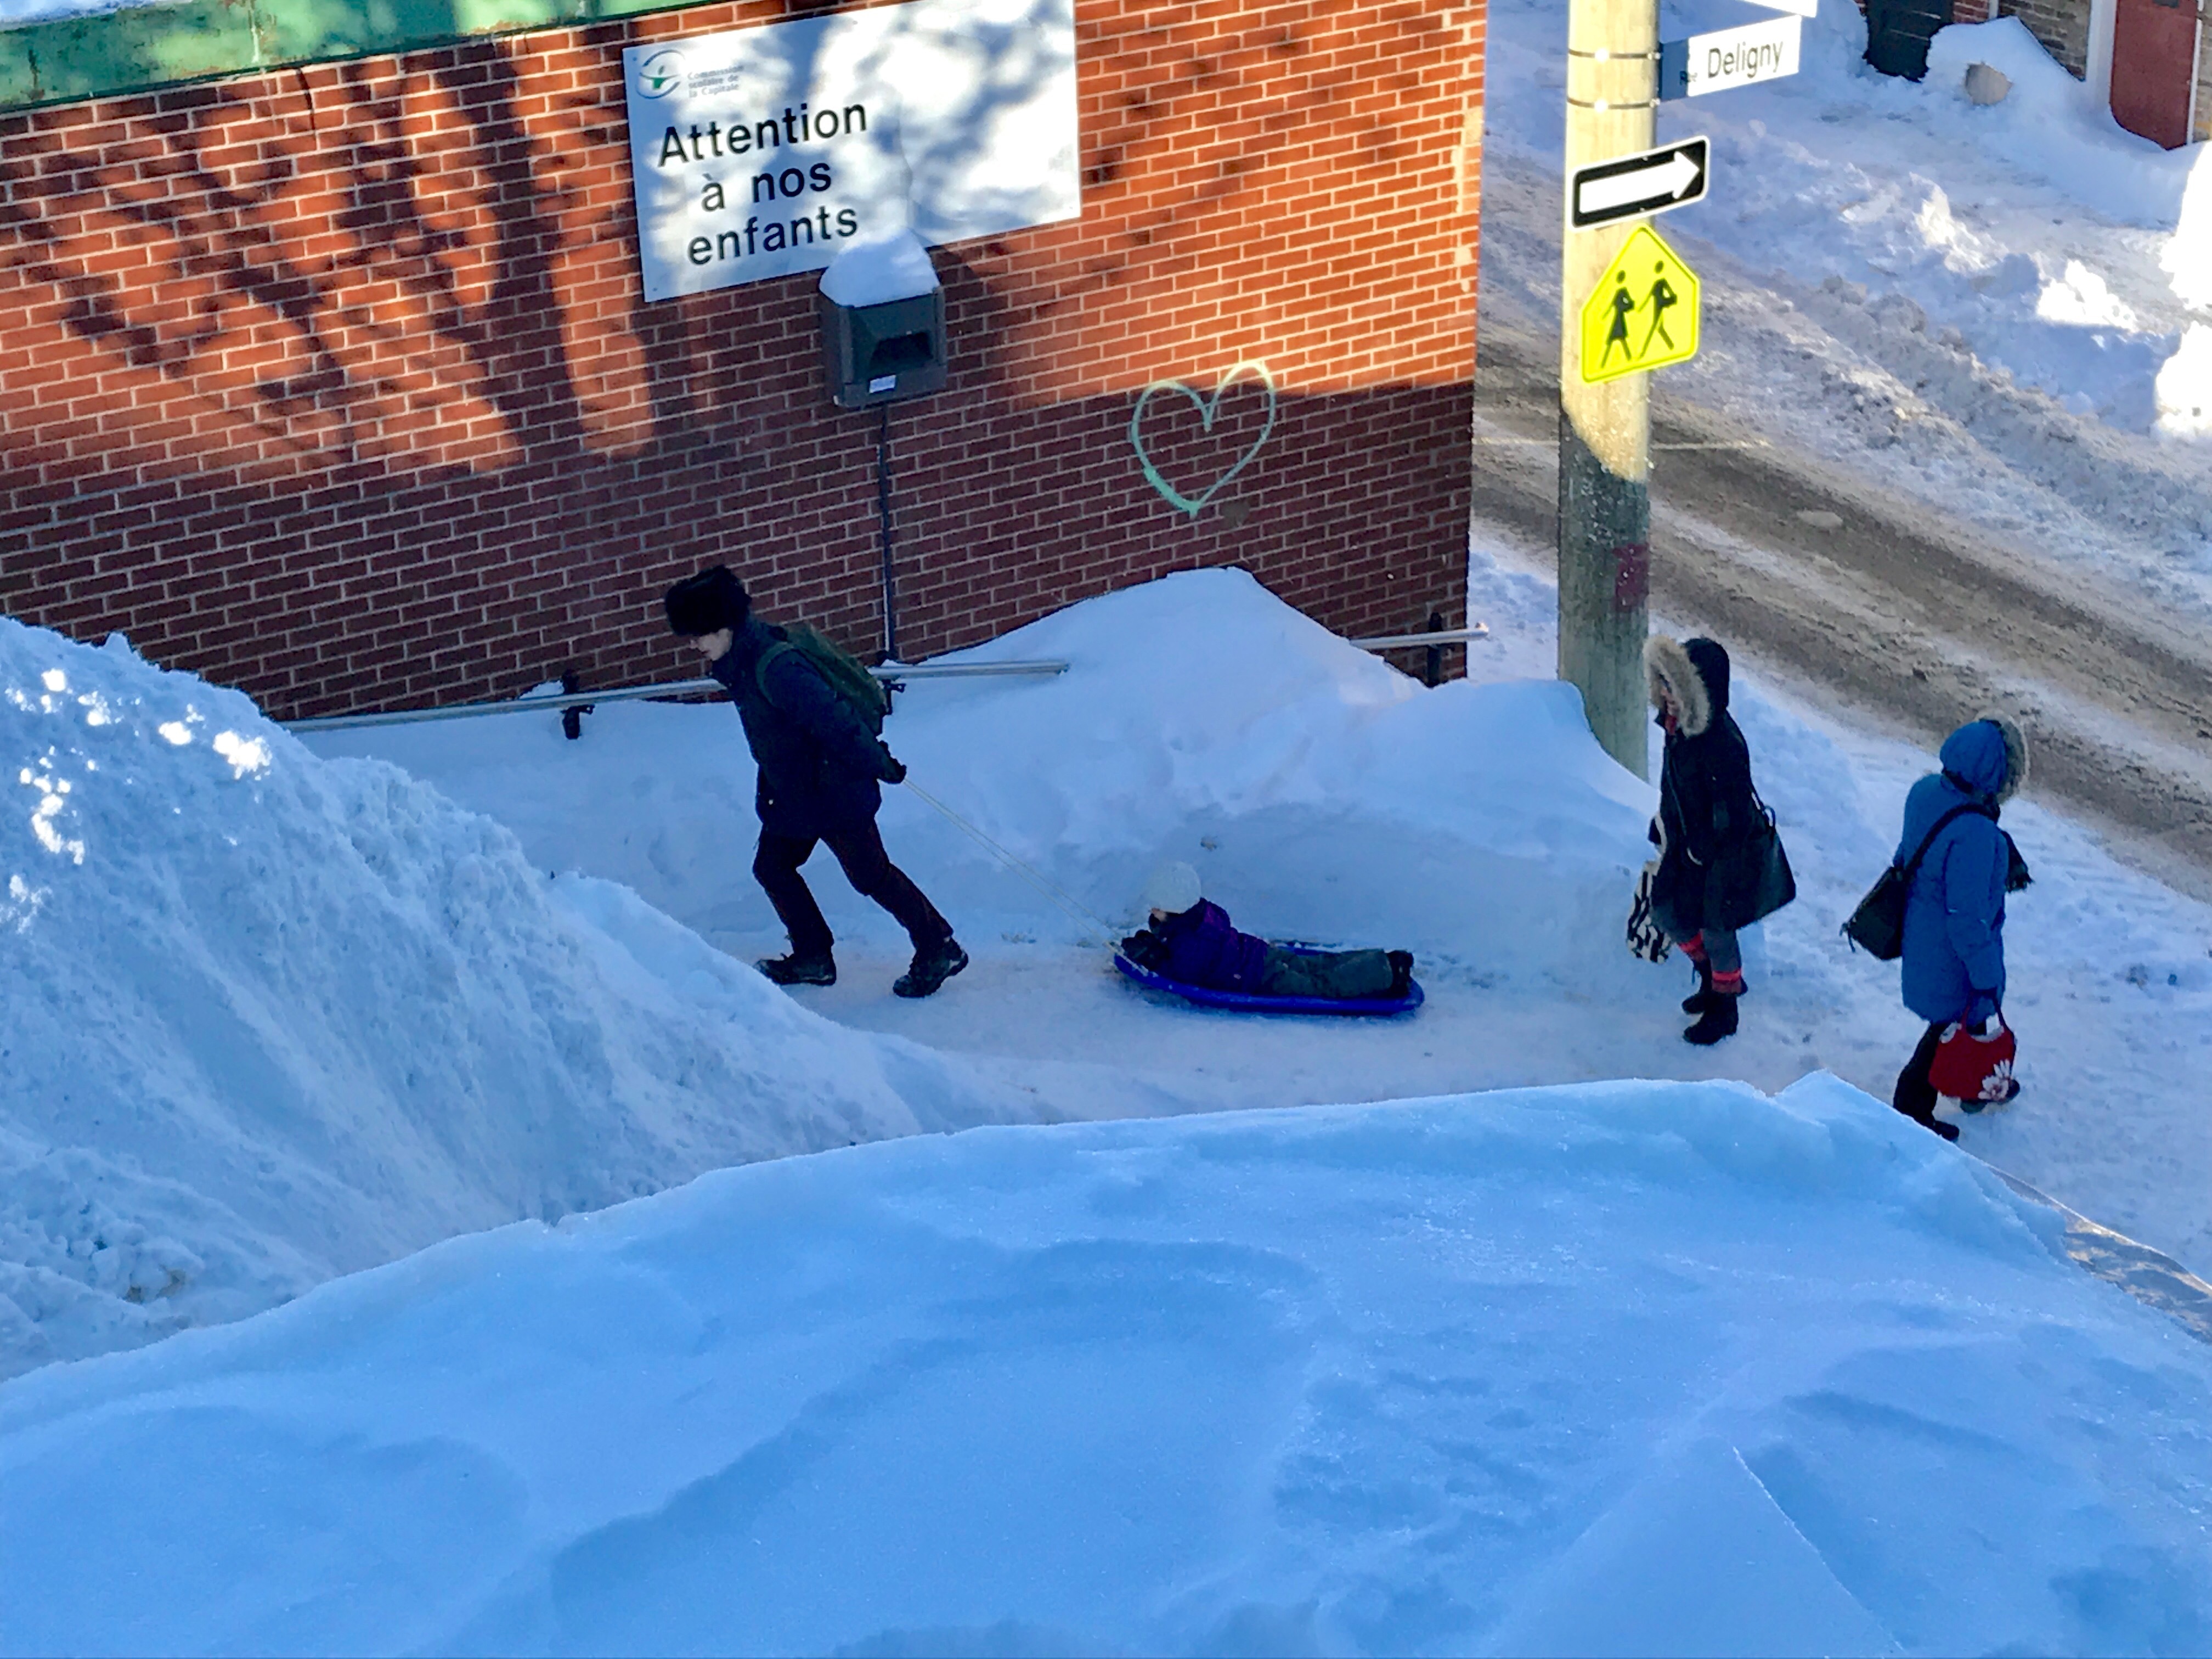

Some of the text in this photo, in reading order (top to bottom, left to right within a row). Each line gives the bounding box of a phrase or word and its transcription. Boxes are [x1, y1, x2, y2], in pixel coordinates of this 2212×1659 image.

[1708, 42, 1783, 78] Deligny
[658, 104, 866, 167] Attention
[702, 163, 831, 212] à nos
[688, 206, 857, 264] enfants
